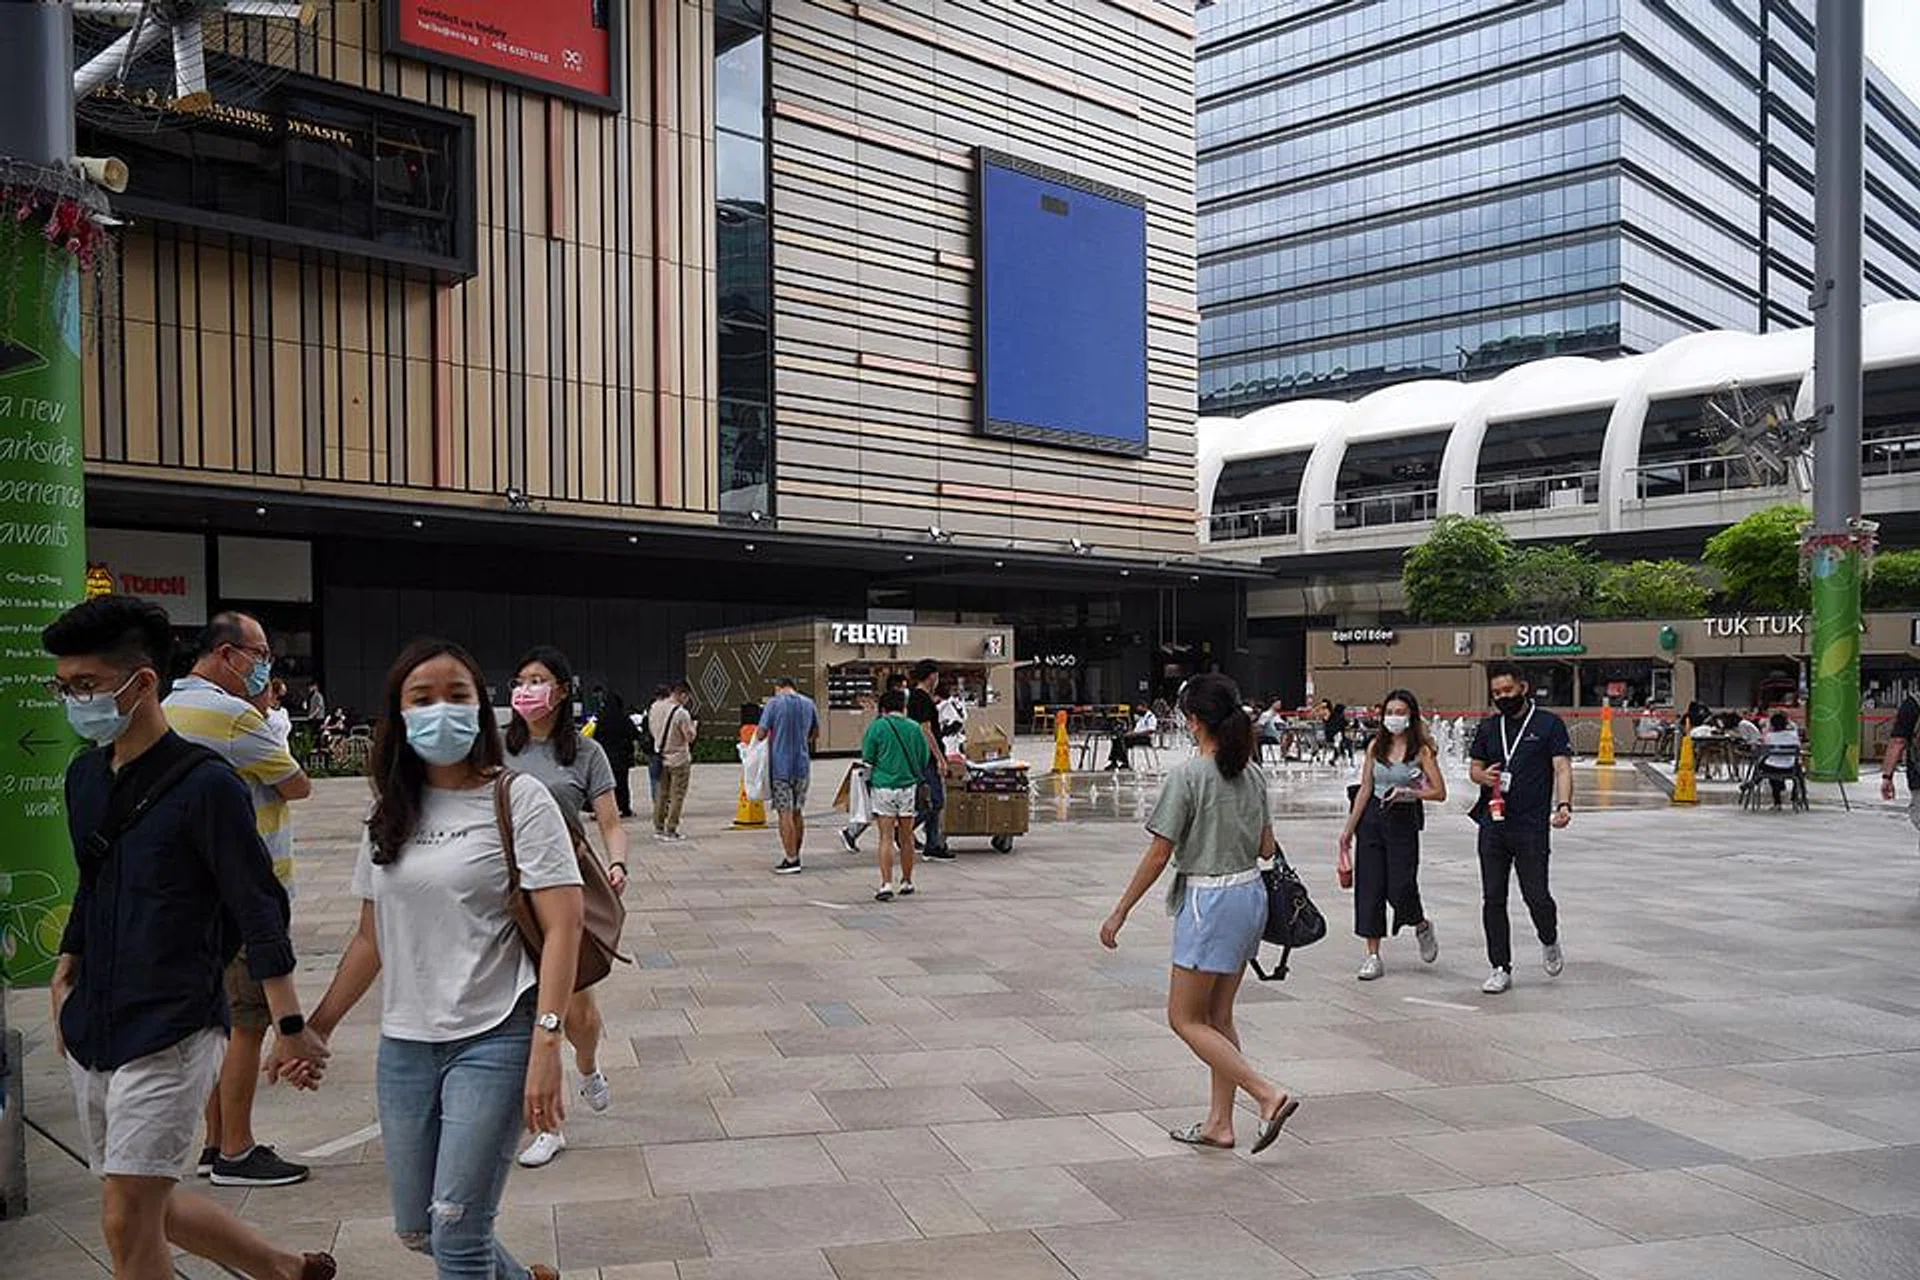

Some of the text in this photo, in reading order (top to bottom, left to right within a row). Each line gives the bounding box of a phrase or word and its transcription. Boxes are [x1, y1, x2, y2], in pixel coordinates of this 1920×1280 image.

[204, 103, 272, 125] ARADISE
[20, 398, 66, 423] new
[0, 431, 74, 467] arkside
[1516, 619, 1580, 646] smol
[1703, 614, 1804, 636] TUK TUK
